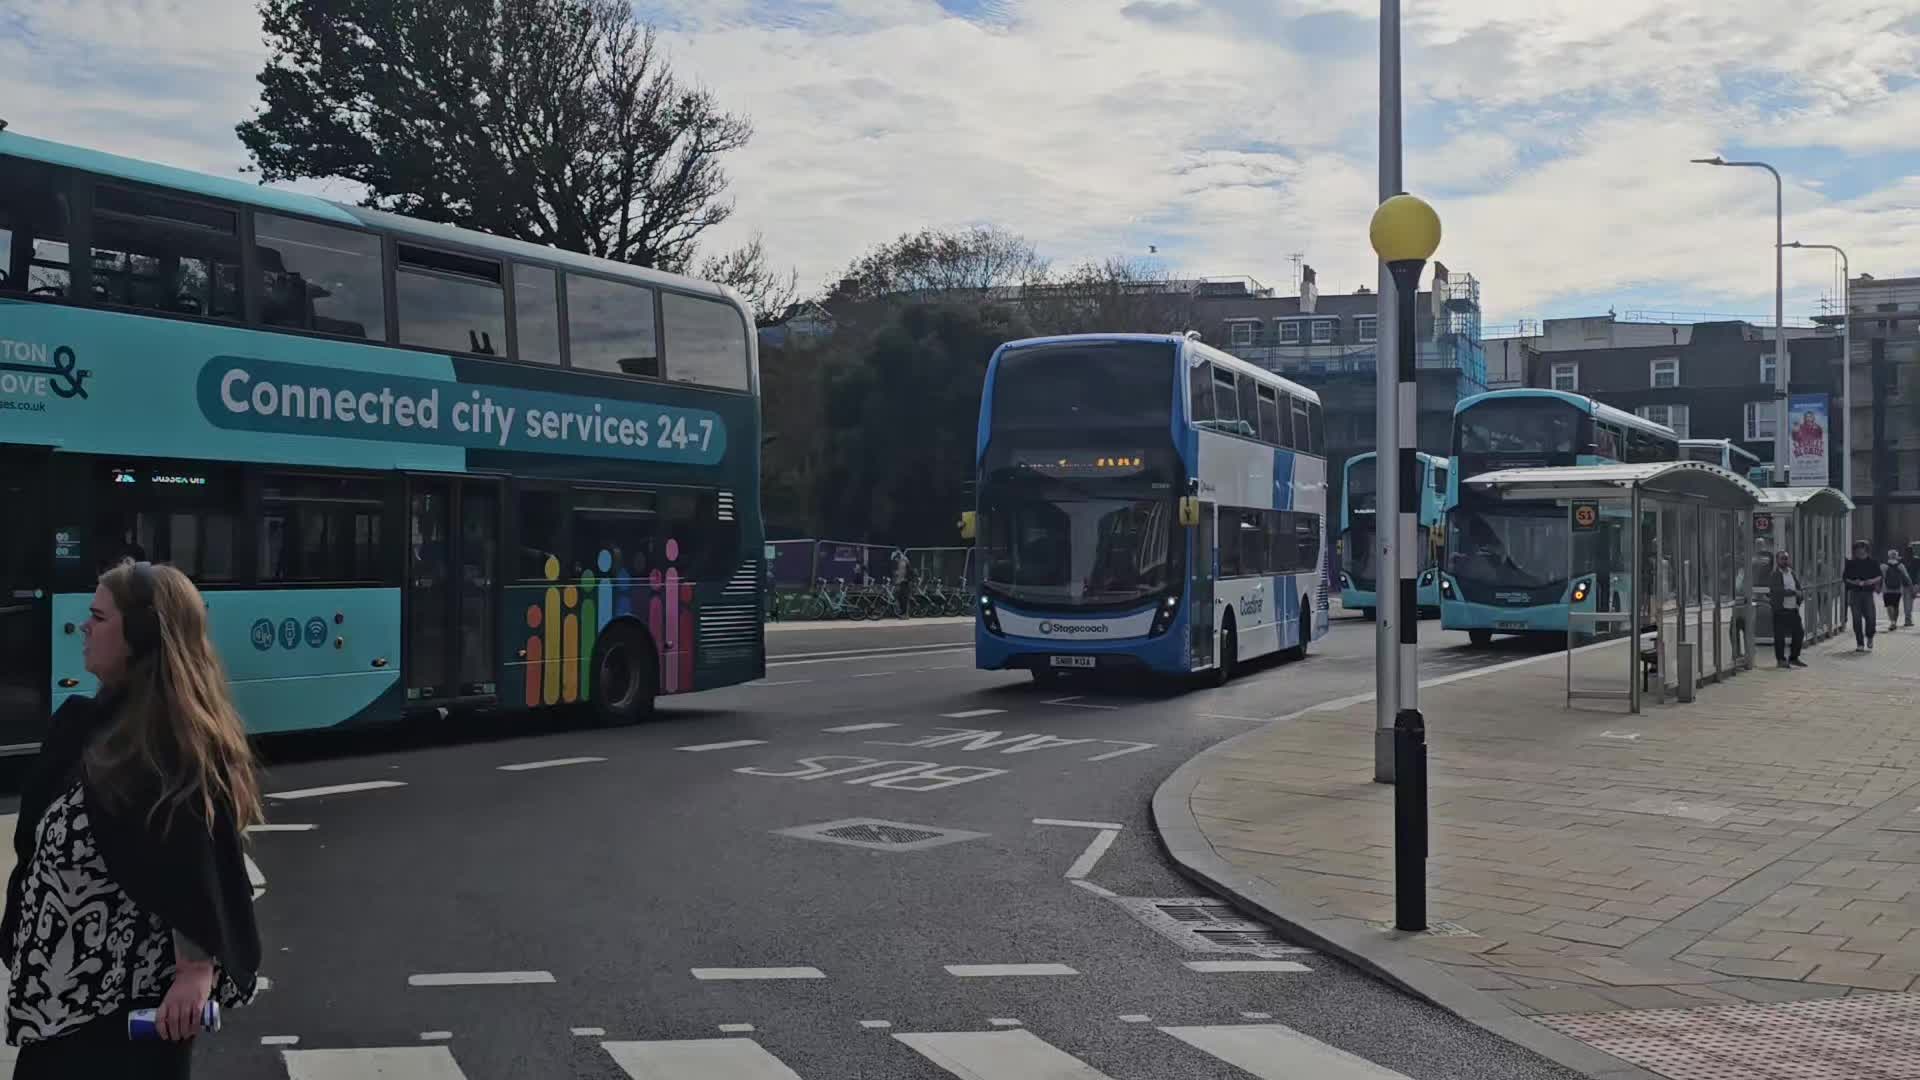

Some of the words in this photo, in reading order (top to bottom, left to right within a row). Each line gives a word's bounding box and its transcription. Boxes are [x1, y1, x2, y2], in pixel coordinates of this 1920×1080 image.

[221, 368, 439, 429] Connected
[452, 391, 515, 446] city
[526, 404, 648, 447] services
[656, 413, 713, 452] 24-7
[1053, 623, 1109, 634] Stagecoach
[863, 727, 1158, 761] LANE
[732, 755, 1009, 792] BUS
